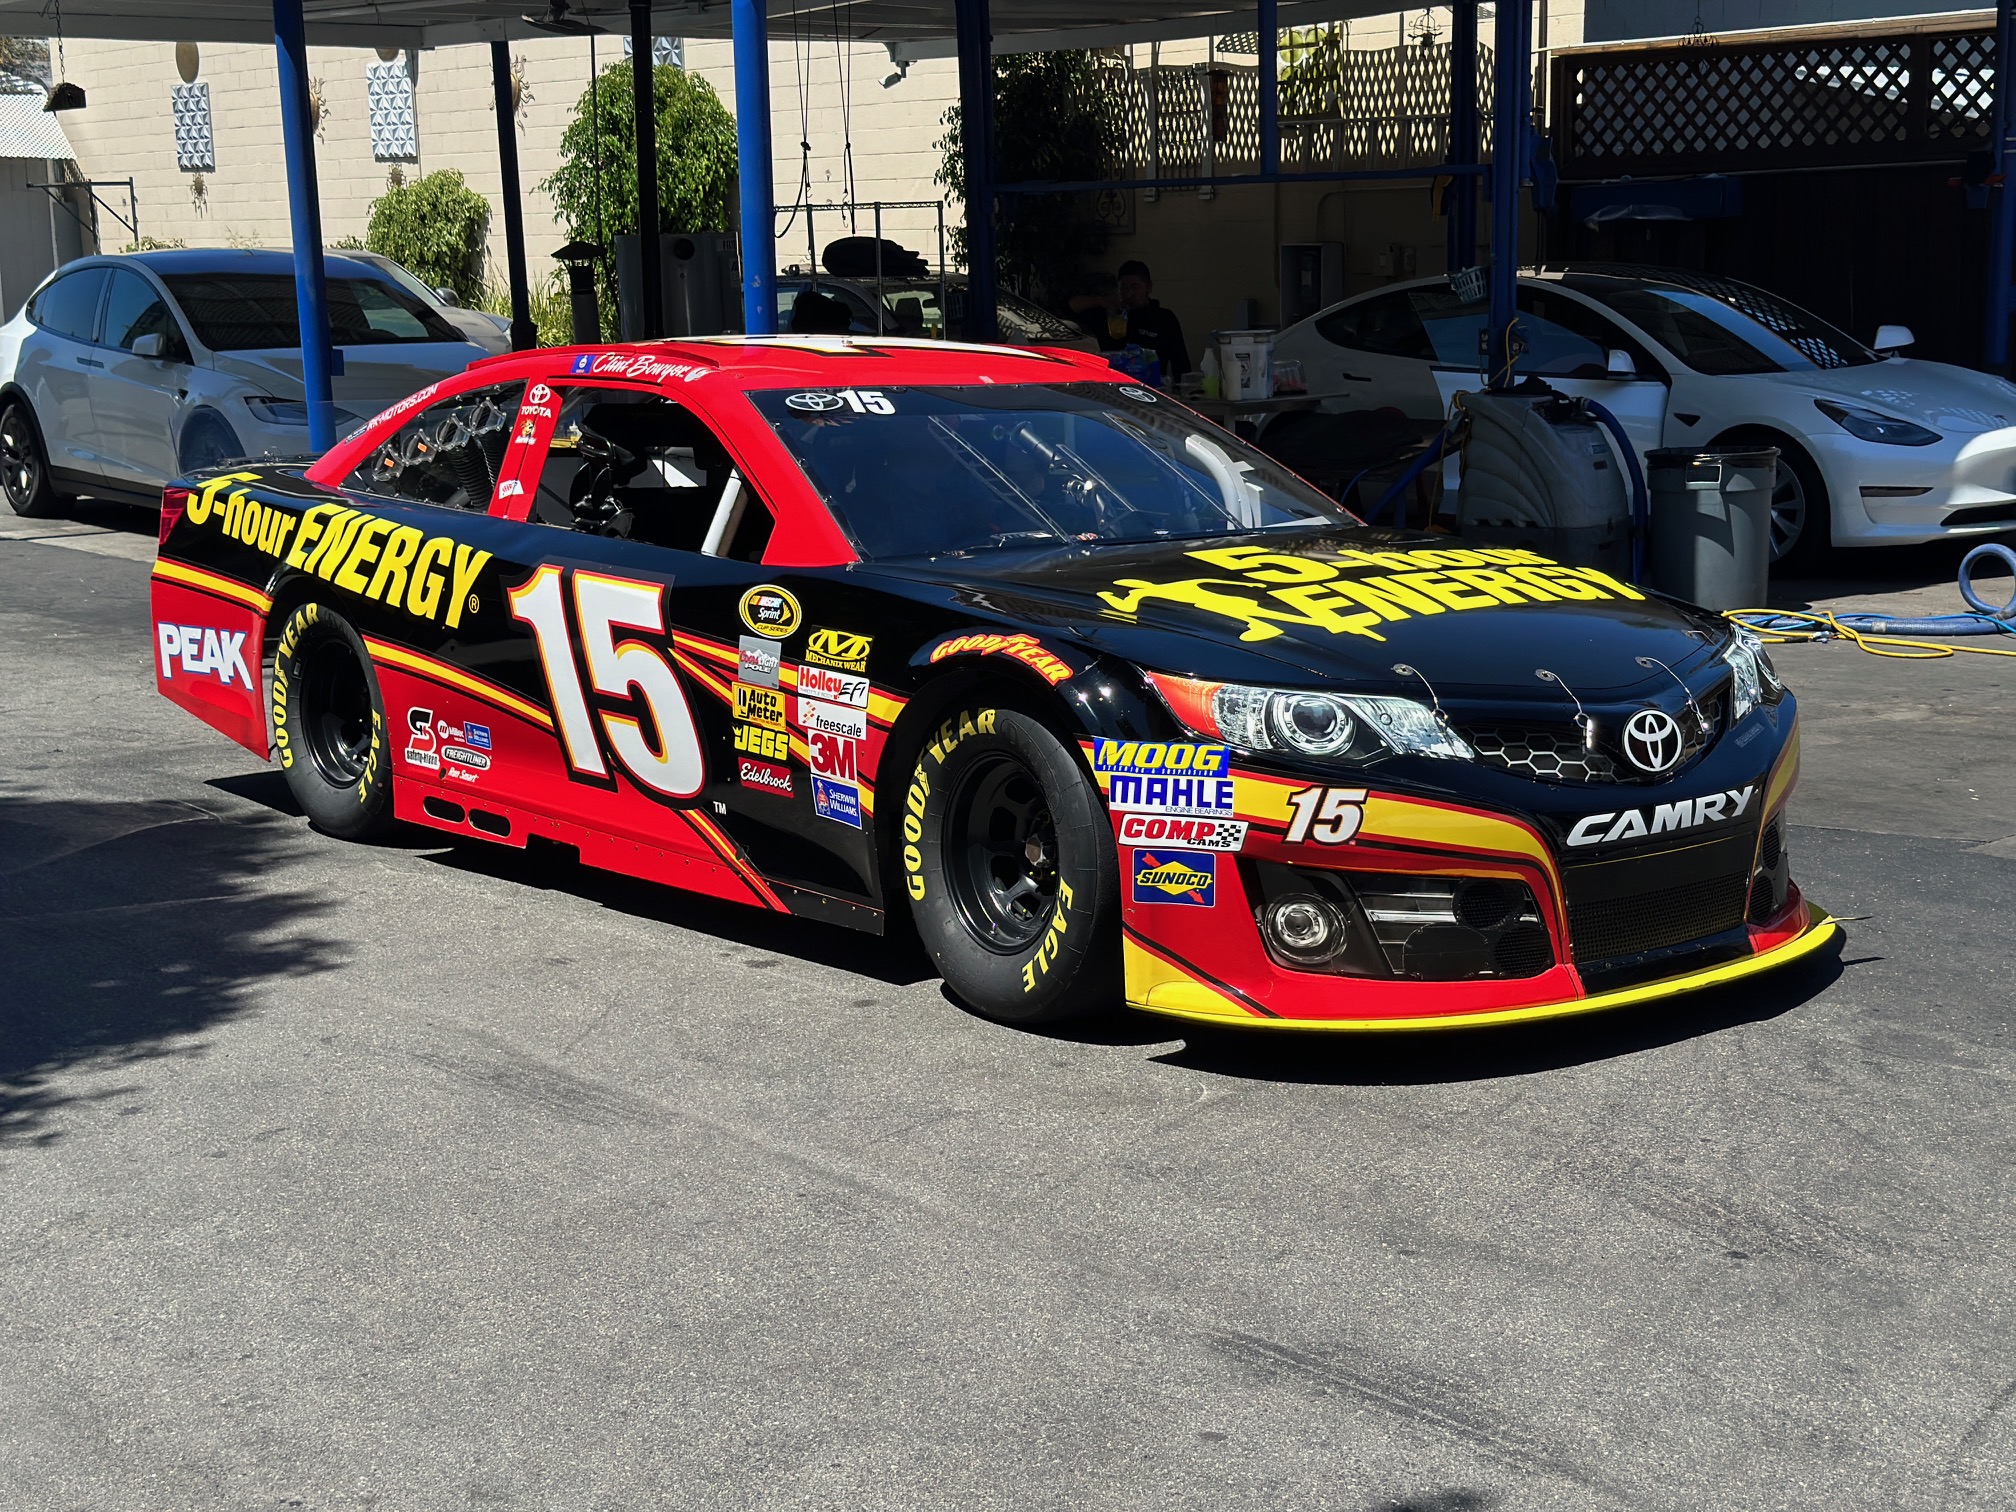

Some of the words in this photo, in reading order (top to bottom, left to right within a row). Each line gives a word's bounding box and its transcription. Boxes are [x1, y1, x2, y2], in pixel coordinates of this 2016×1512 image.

[593, 352, 633, 373] Clint
[626, 355, 692, 383] Bowyer
[837, 390, 896, 415] 15
[186, 471, 296, 559] 5-hour
[285, 502, 494, 630] ENERGY
[1183, 546, 1558, 584] 5-hour
[757, 607, 781, 620] Sprint
[1267, 566, 1647, 633] ENERGY
[157, 621, 254, 691] PEAK
[745, 663, 771, 674] POLE
[758, 653, 779, 668] LIGHT
[805, 649, 844, 668] MECHANIX
[843, 660, 867, 672] WEAR
[930, 634, 1074, 686] GOODYEAR
[507, 563, 704, 798] 15
[799, 666, 842, 700] Holley
[838, 681, 867, 702] EFI
[746, 702, 783, 723] Meter
[749, 689, 777, 708] Auto
[815, 714, 862, 738] freescale
[357, 708, 382, 804] EAGLE
[446, 748, 487, 767] FREIGHTLINER
[733, 724, 789, 761] JEGS
[810, 732, 855, 781] 3M
[1098, 741, 1225, 771] MOOG
[740, 762, 792, 792] Edelbrock
[1110, 774, 1233, 810] MAHLE
[713, 801, 727, 815] TM
[829, 789, 856, 806] SHERWIN
[1165, 805, 1194, 814] ENGINE
[1194, 807, 1233, 817] BEARINGS
[1123, 817, 1216, 841] COMP
[1282, 786, 1369, 845] 15
[1566, 785, 1755, 847] CAMRY
[1186, 837, 1232, 848] CAMS
[1140, 871, 1211, 888] SUNOCO
[1021, 876, 1074, 994] EAGLE
